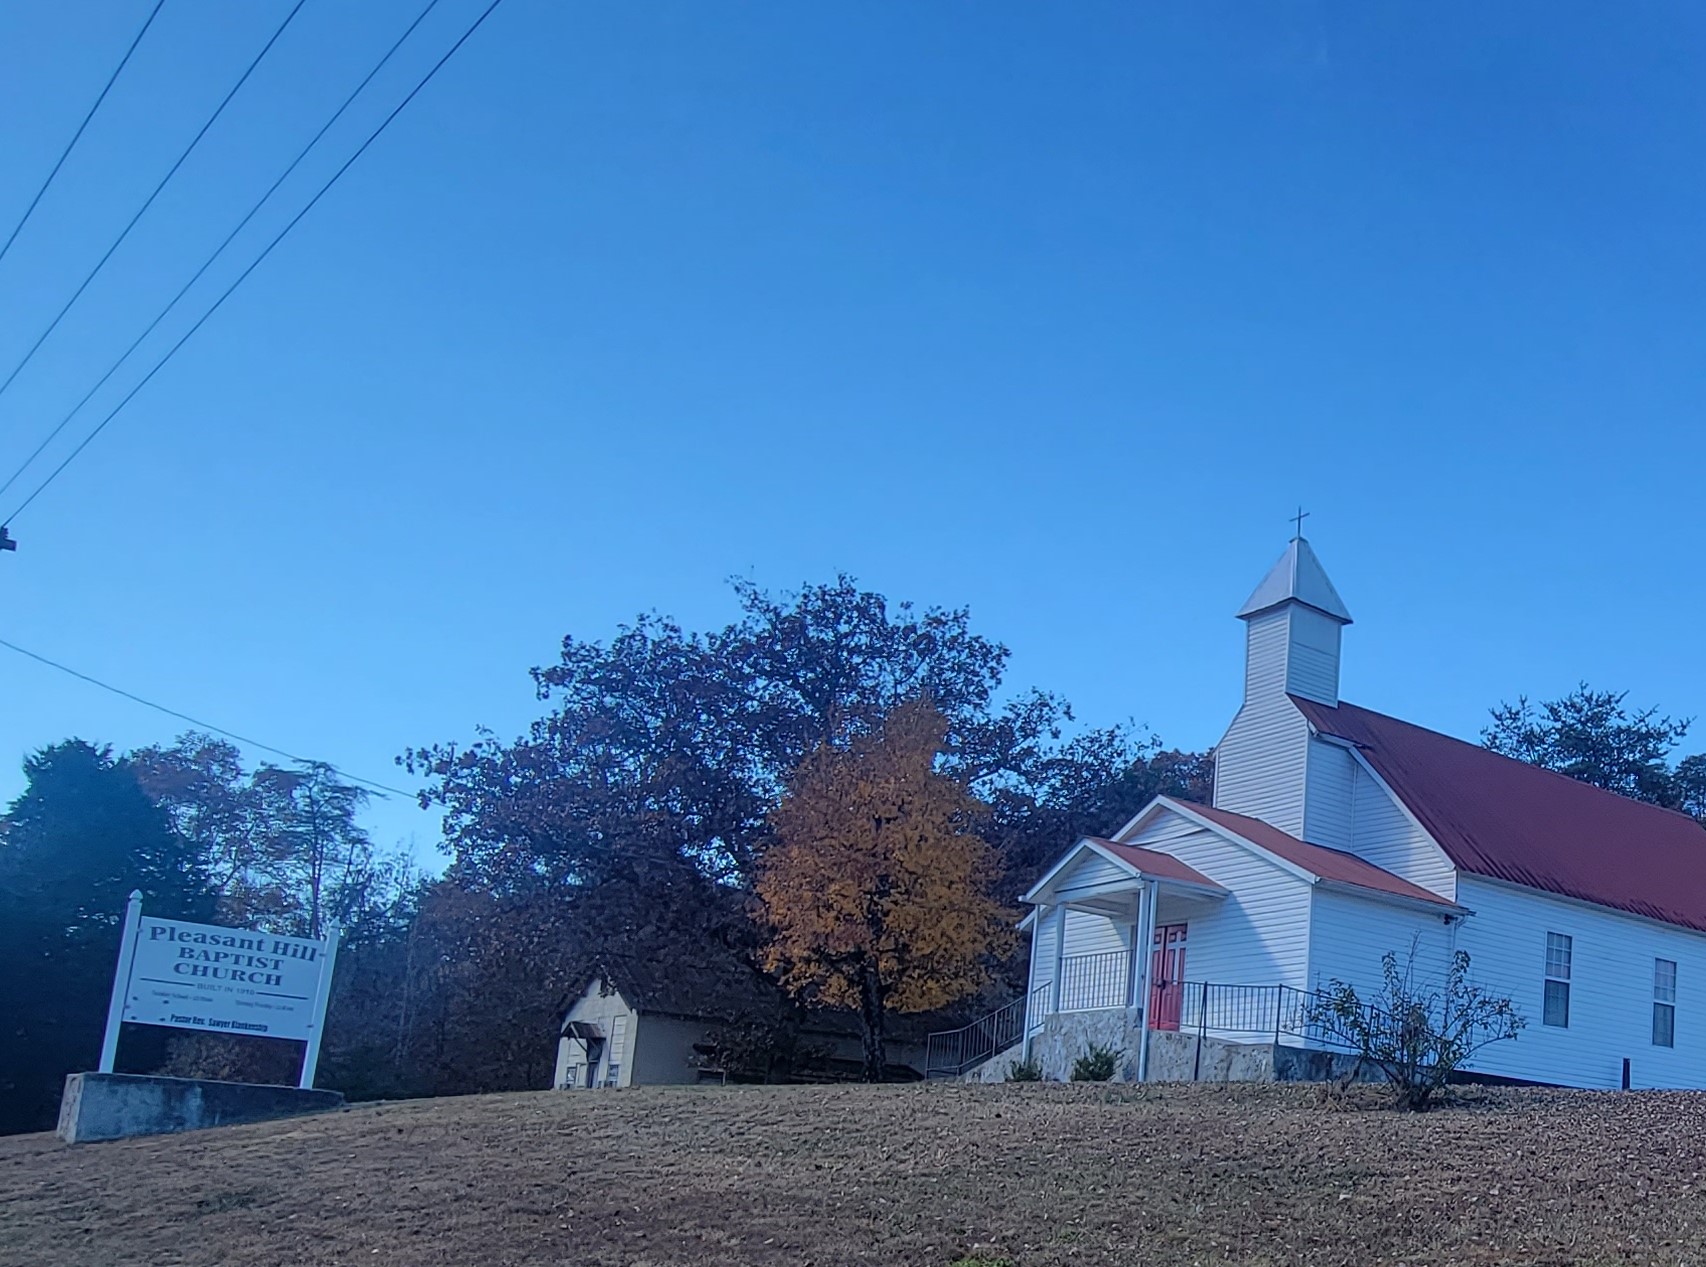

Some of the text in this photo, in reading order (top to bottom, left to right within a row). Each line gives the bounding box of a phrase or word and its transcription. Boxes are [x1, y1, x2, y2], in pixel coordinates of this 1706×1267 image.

[149, 926, 318, 962] Pleasant Hill
[178, 946, 285, 971] BAPTIST
[173, 962, 284, 986] CHURCH
[197, 983, 222, 992] BUILT
[170, 1013, 191, 1025] Pastor
